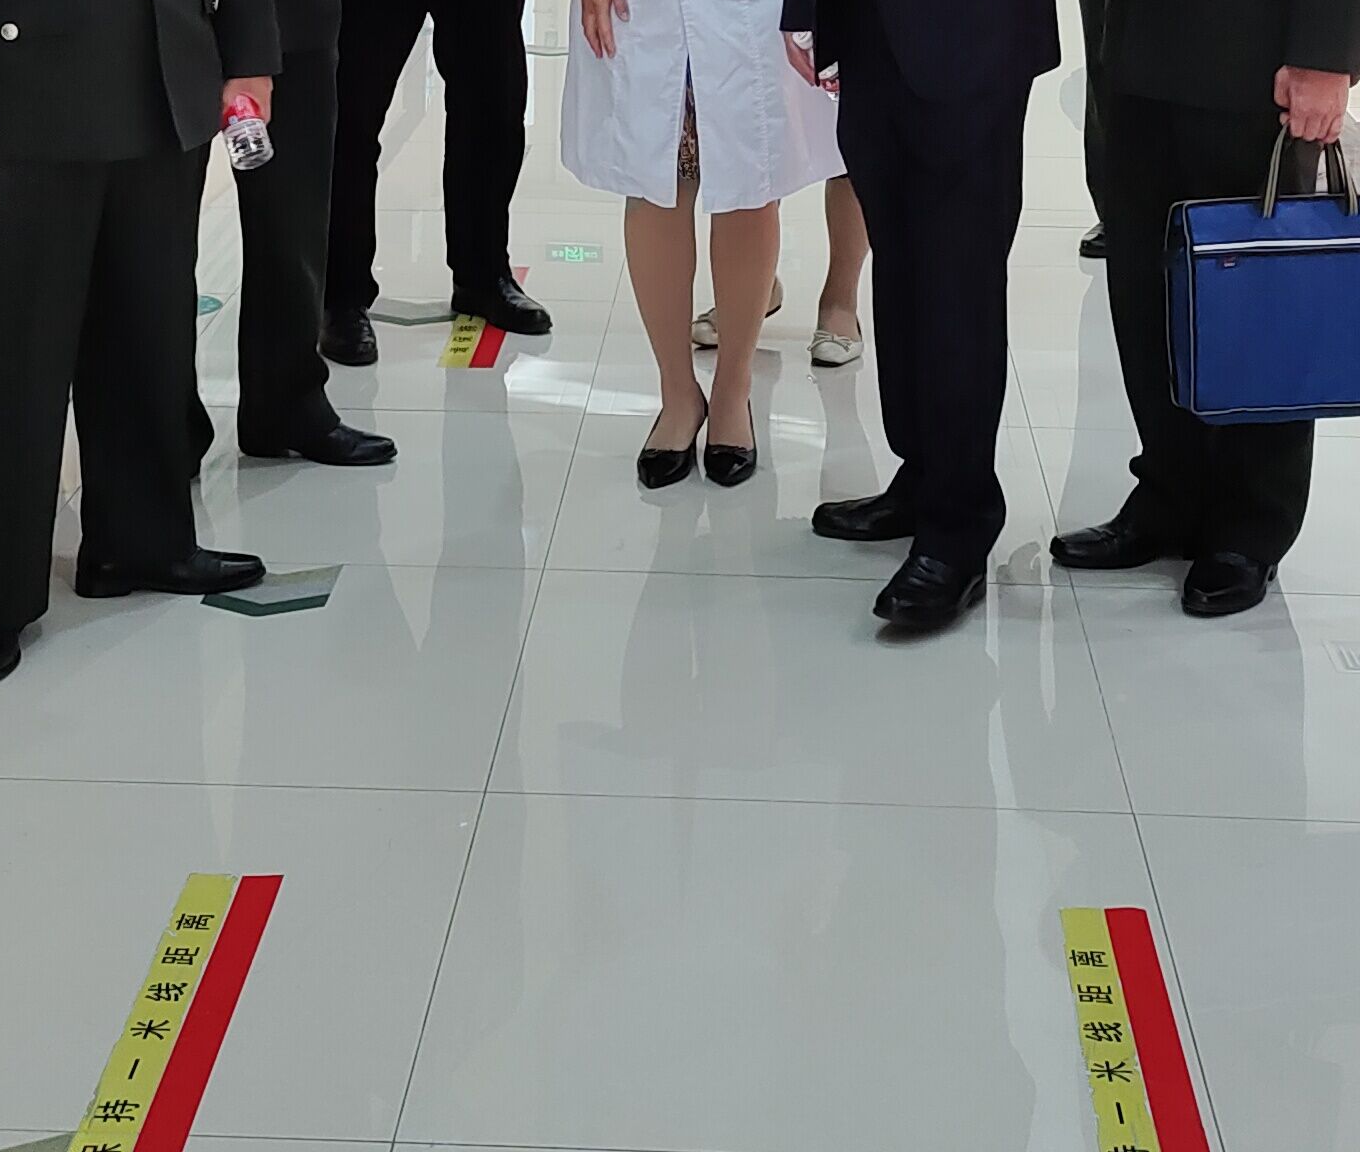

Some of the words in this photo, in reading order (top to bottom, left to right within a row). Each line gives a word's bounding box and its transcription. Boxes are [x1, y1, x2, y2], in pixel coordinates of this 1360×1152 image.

[1068, 949, 1150, 1152] 一米线距离
